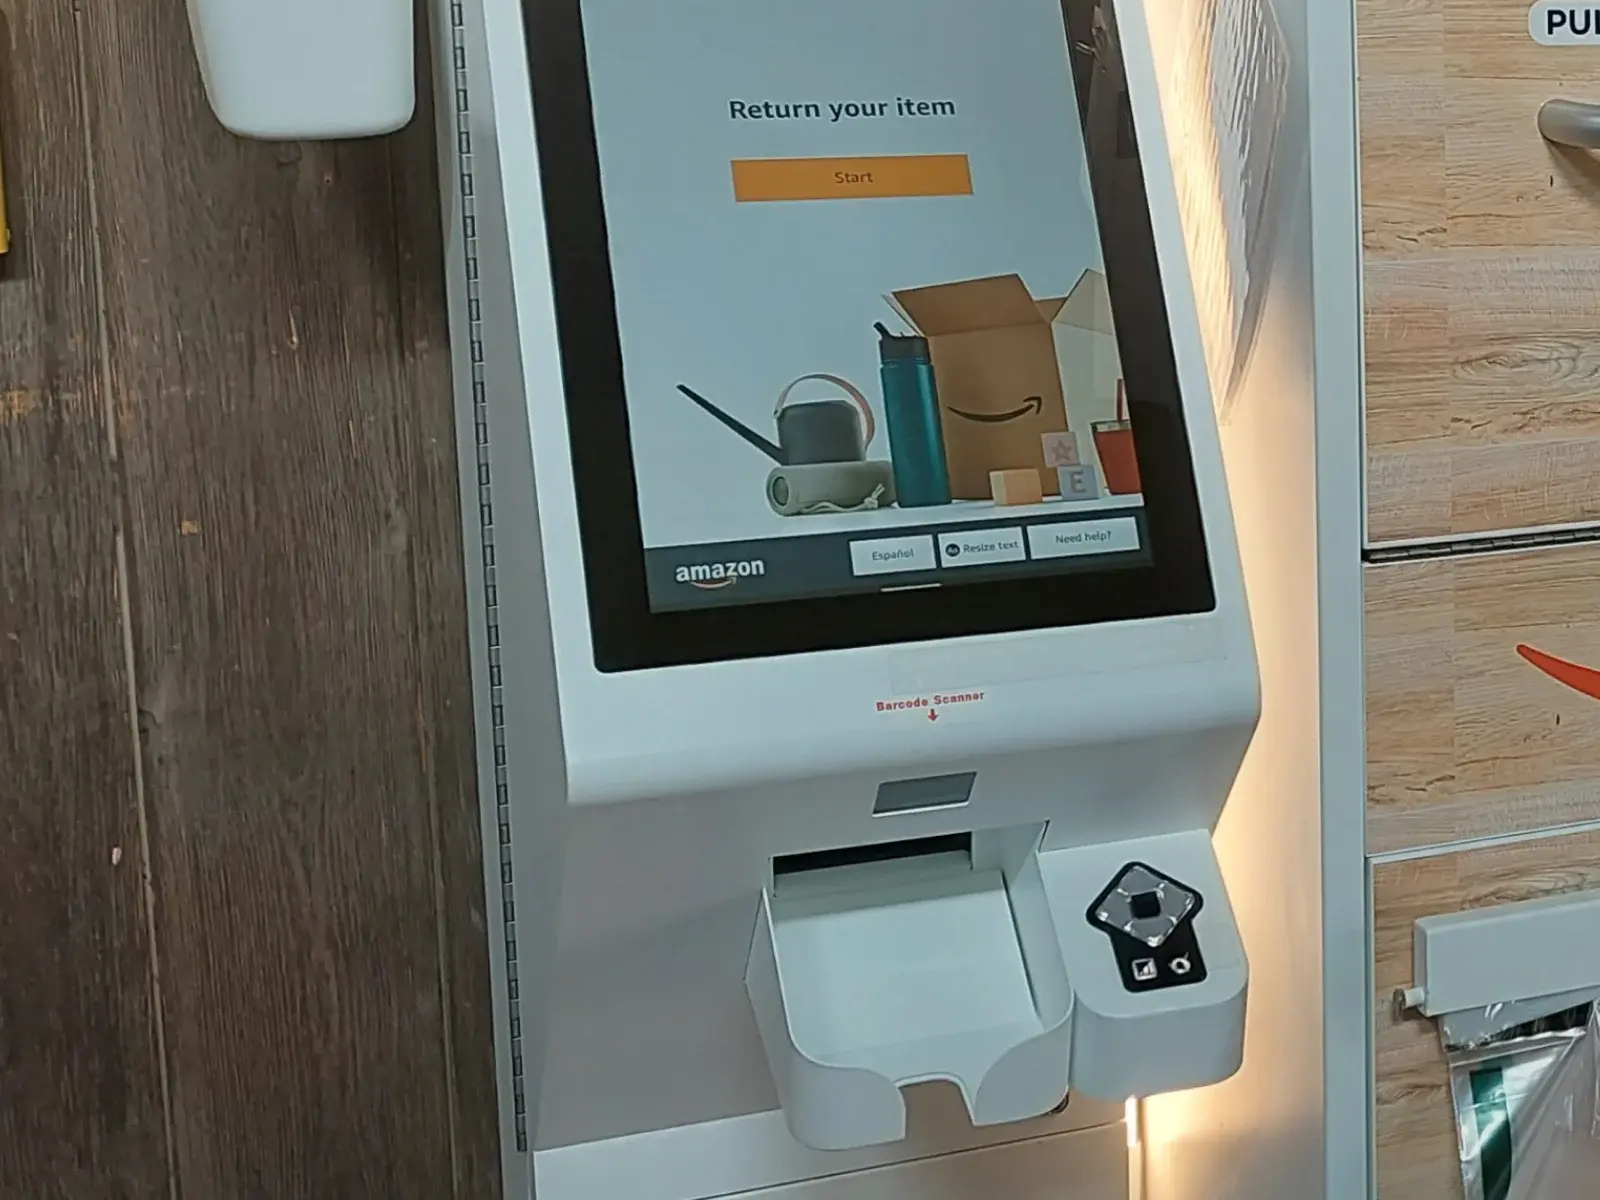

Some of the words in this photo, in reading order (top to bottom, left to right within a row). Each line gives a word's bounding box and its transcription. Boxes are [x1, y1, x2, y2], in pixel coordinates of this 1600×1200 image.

[729, 100, 821, 120] Return
[828, 101, 888, 122] your
[896, 97, 956, 116] item
[834, 171, 873, 184] Start
[1055, 533, 1082, 544] Need
[1084, 530, 1112, 543] help?
[963, 543, 995, 553] Resize
[998, 540, 1019, 550] text
[872, 548, 914, 562] Español
[675, 560, 765, 583] amazon
[876, 696, 928, 712] Barcode
[933, 692, 984, 705] Scanner
